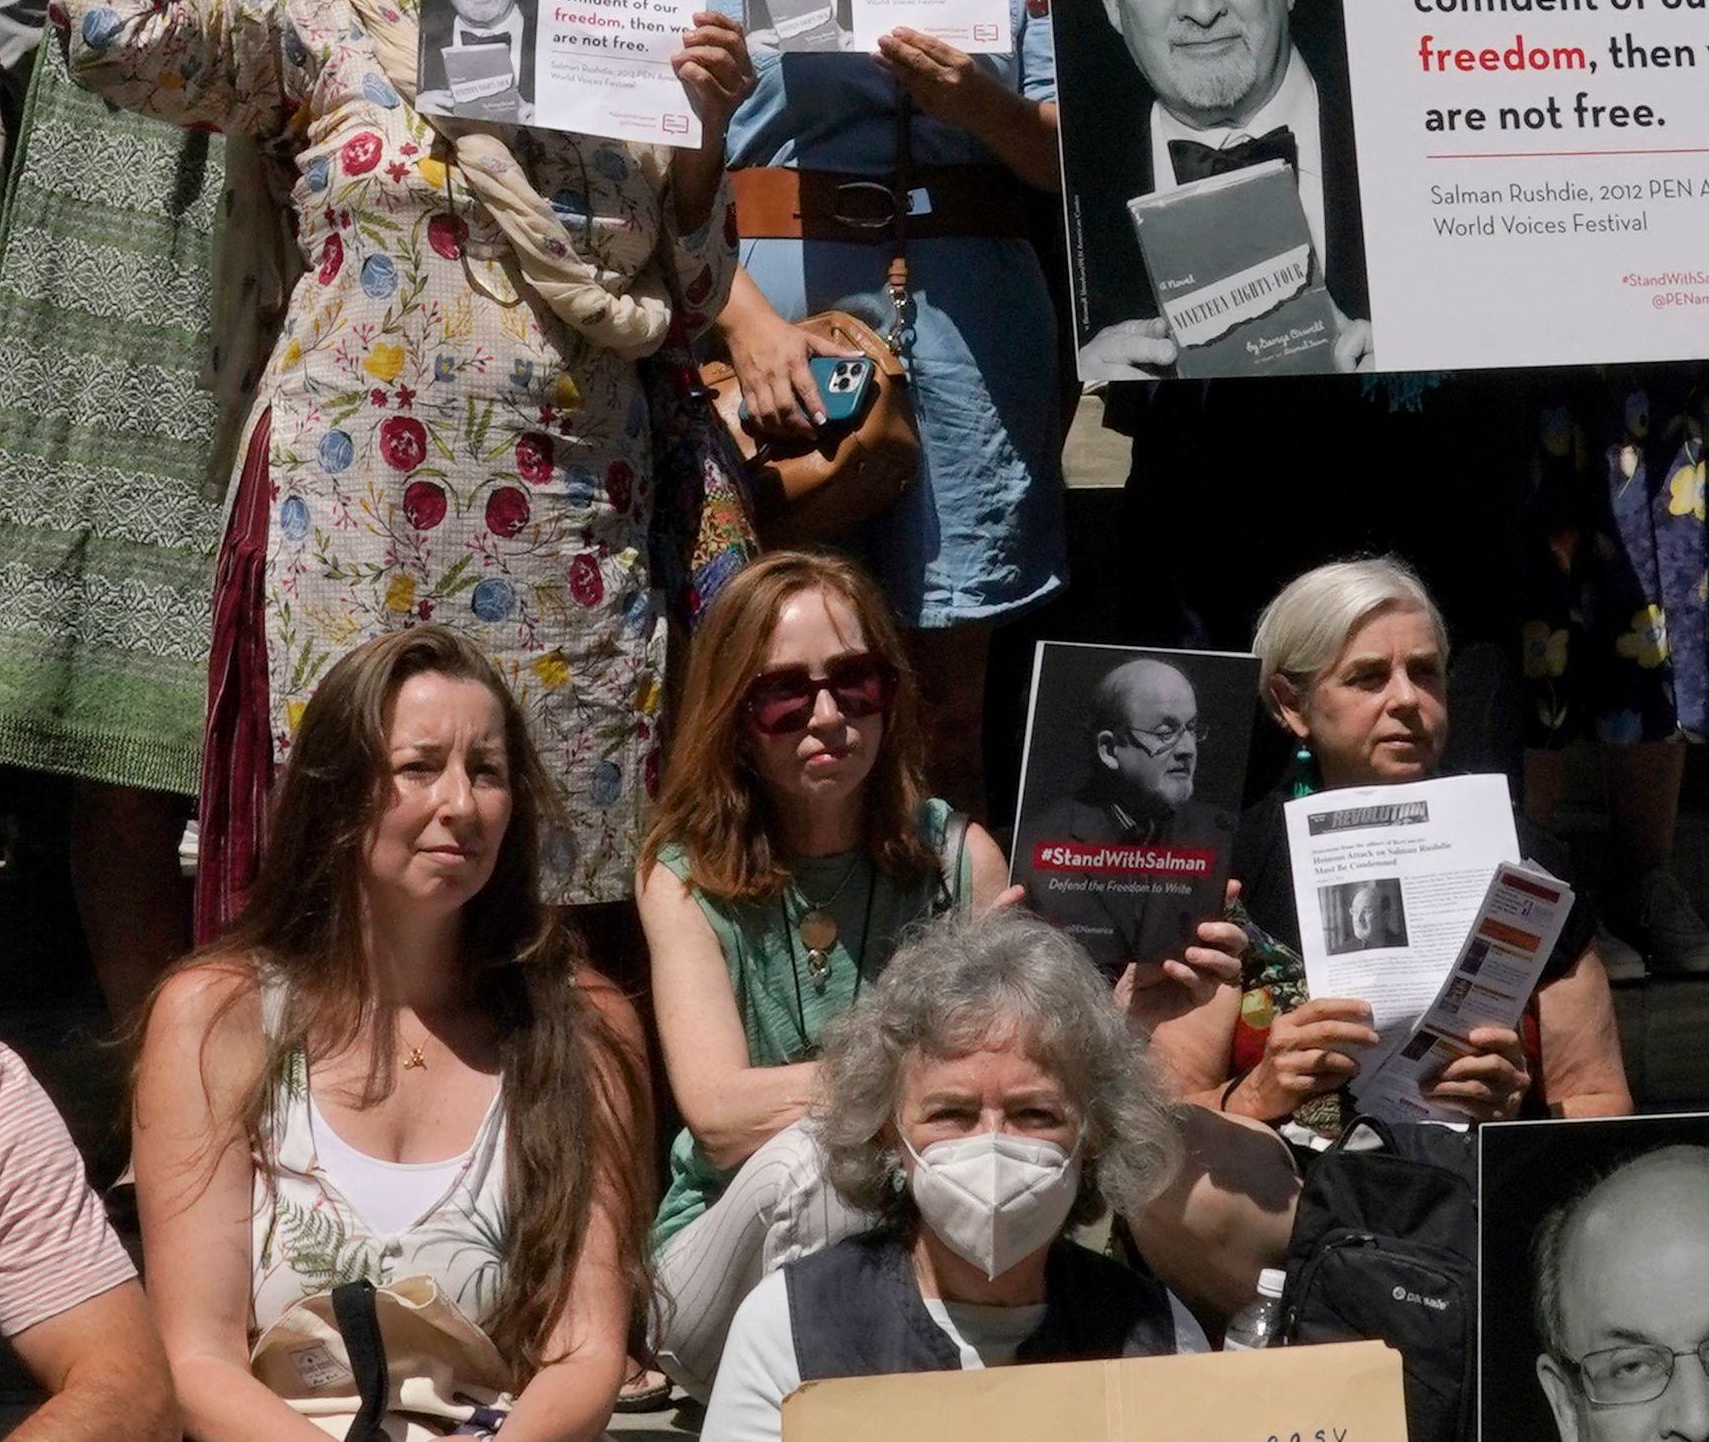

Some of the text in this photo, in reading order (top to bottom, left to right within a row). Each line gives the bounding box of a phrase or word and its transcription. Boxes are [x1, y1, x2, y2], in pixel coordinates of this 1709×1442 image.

[633, 0, 649, 9] of
[653, 3, 678, 14] our
[554, 8, 665, 32] freedom, then
[552, 34, 649, 52] are not free.
[1419, 34, 1598, 75] freedom,
[1609, 32, 1696, 69] then
[1424, 91, 1666, 132] are not free.
[1430, 183, 1504, 206] Salman
[1510, 180, 1594, 204] Rushdie,
[1600, 183, 1644, 202] 2012
[1649, 180, 1693, 199] PEN
[1432, 210, 1649, 238] World Voices Festival
[1172, 297, 1228, 331] NINETEEN
[1041, 847, 1206, 871] #StandWithSalman
[1048, 878, 1192, 895] Defend the Freedom Write
